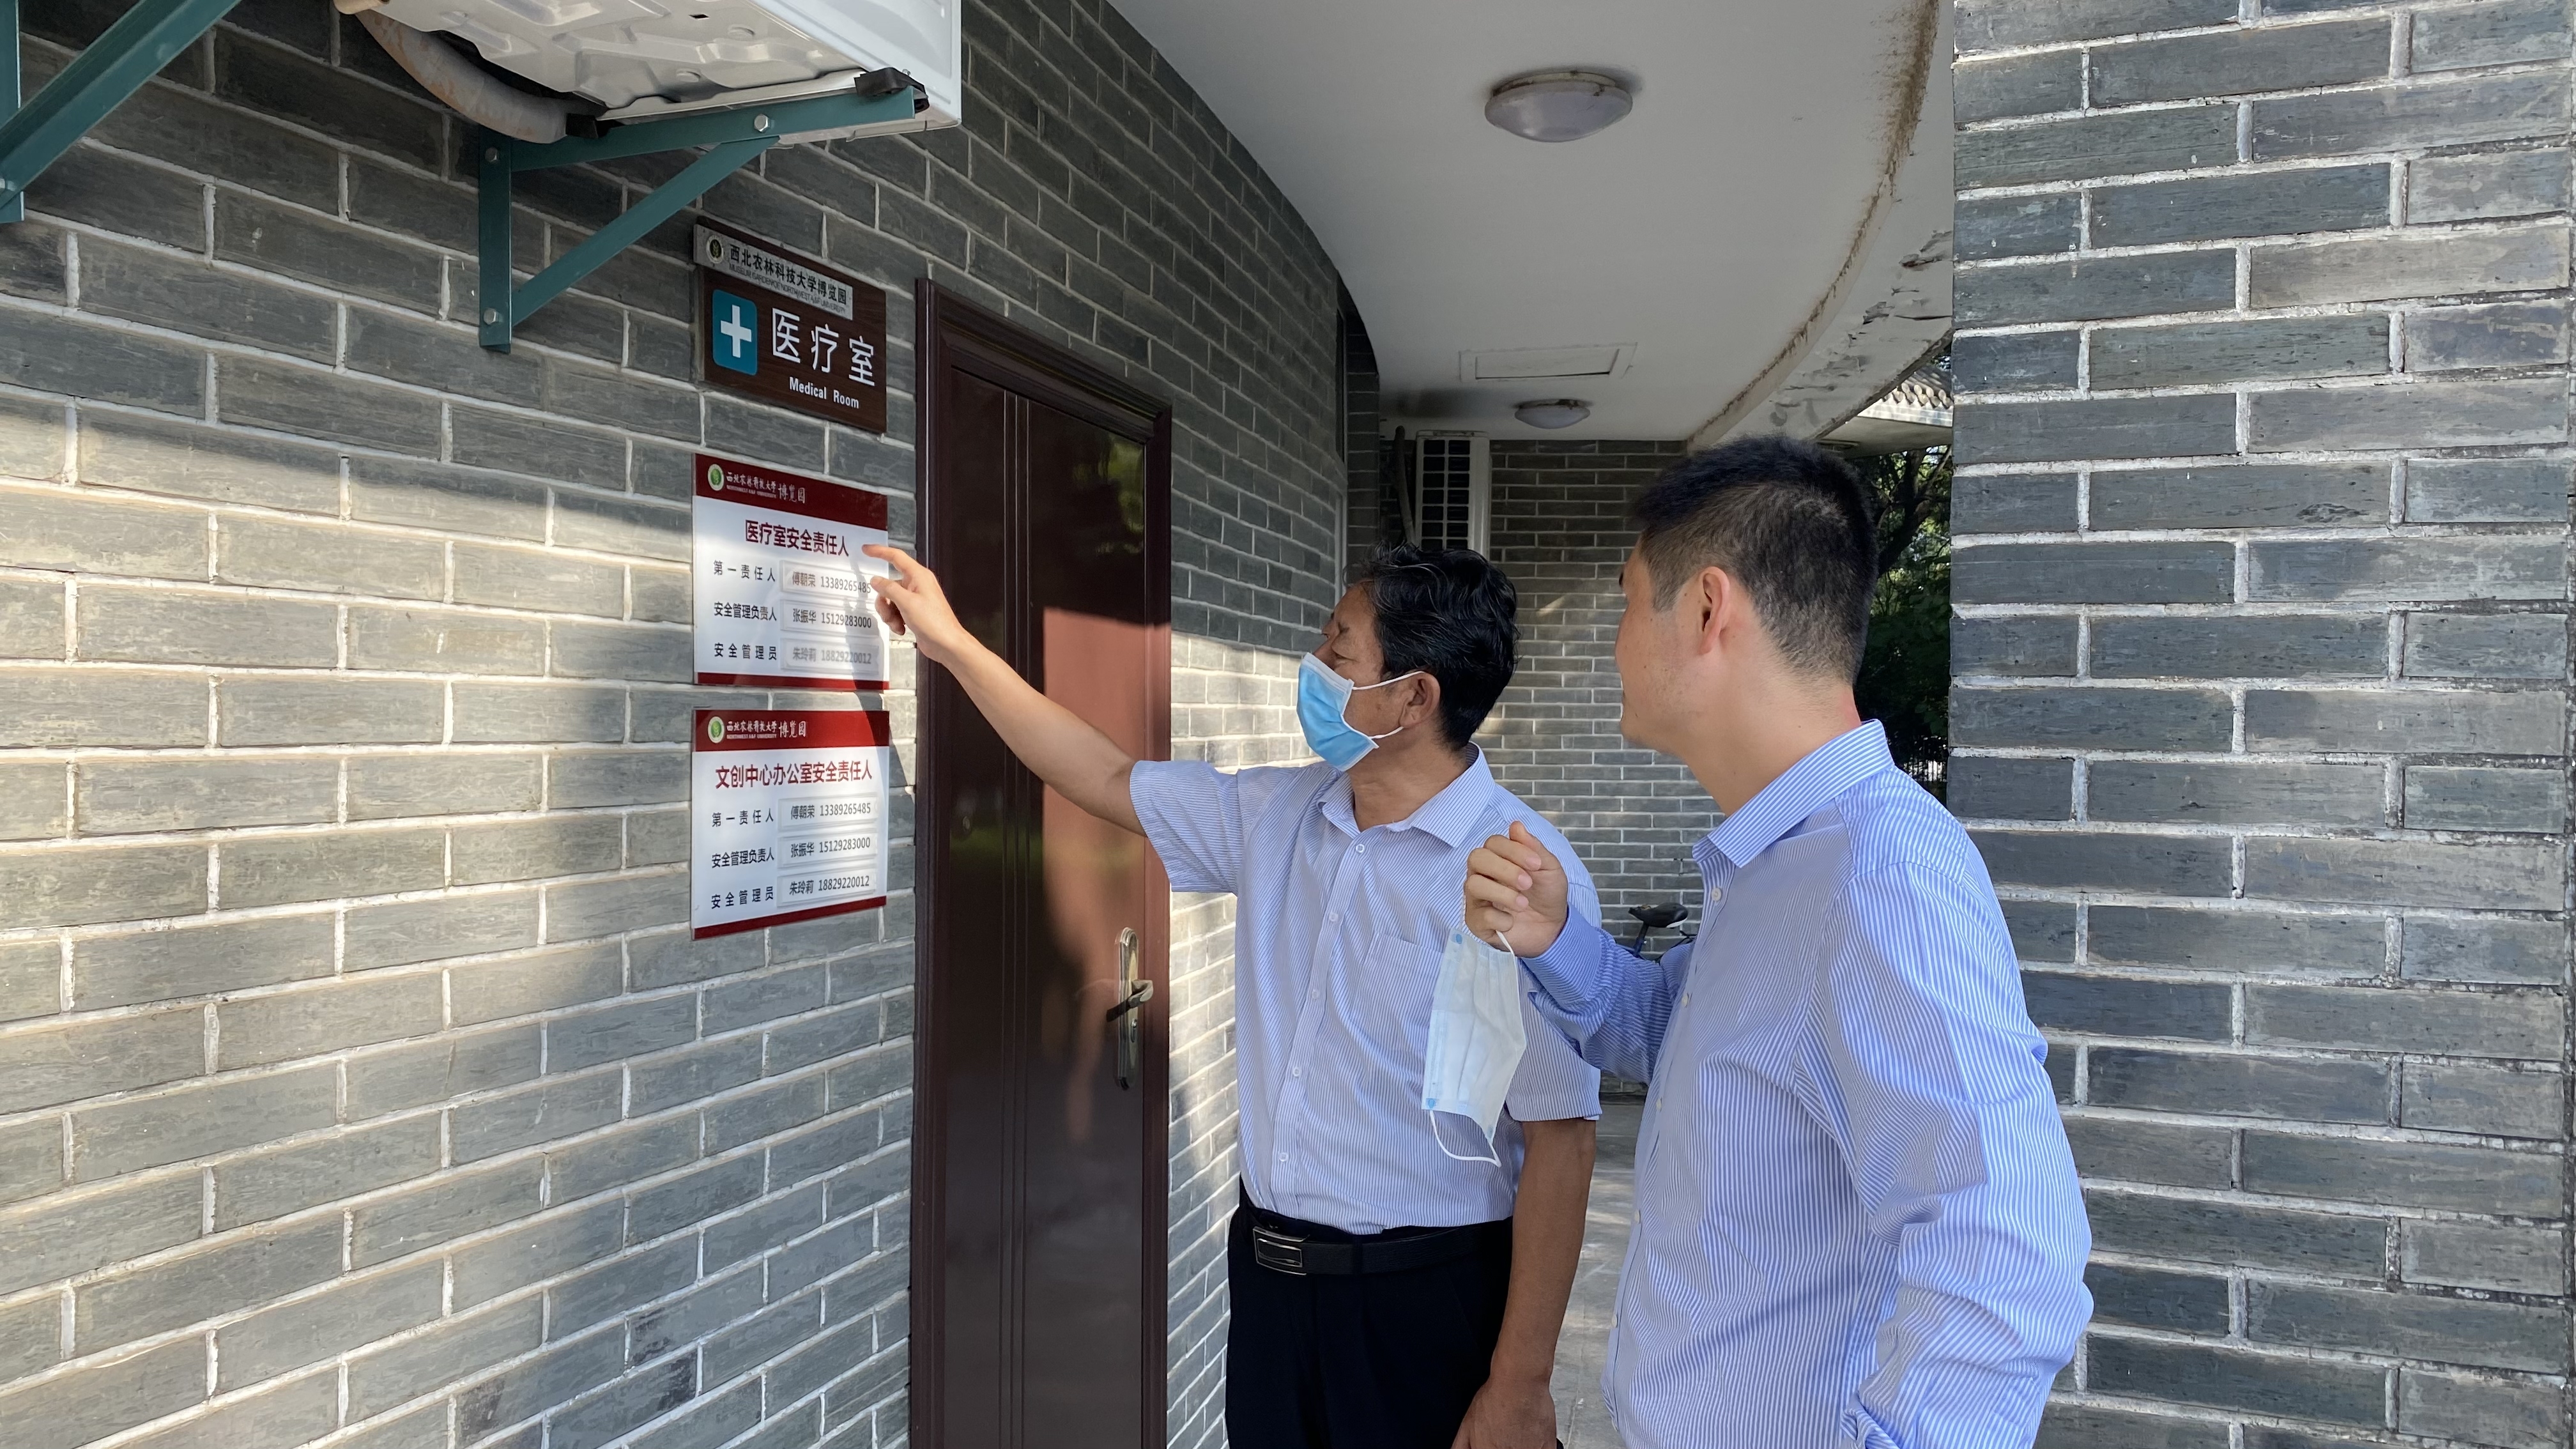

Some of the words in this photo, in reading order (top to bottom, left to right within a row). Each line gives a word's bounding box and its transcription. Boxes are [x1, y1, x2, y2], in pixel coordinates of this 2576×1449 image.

[730, 244, 847, 305] 西北农林科技大学博览园
[772, 307, 875, 387] 医疗室
[789, 376, 827, 400] Medical
[833, 389, 859, 409] Room
[745, 519, 849, 557] 医疗室安全责任人
[713, 560, 776, 583] 第一责任人
[820, 576, 871, 594] 13389265485
[714, 601, 777, 622] 安全管理负责人
[792, 608, 816, 624] 张振华
[821, 612, 871, 629] 15129283000
[714, 642, 777, 661] 安全管理员
[821, 649, 871, 665] 18829220012
[715, 759, 872, 789] 文创中心办公室安全责任人
[711, 808, 774, 827] 第一责任人
[820, 802, 871, 816] 13389265485
[711, 847, 775, 869] 安全管理负责人
[790, 841, 815, 858] 张振华
[819, 836, 871, 853] 15129283000
[789, 880, 815, 896] 朱玲莉
[818, 875, 870, 891] 18829220012
[711, 886, 774, 910] 安全管理员
